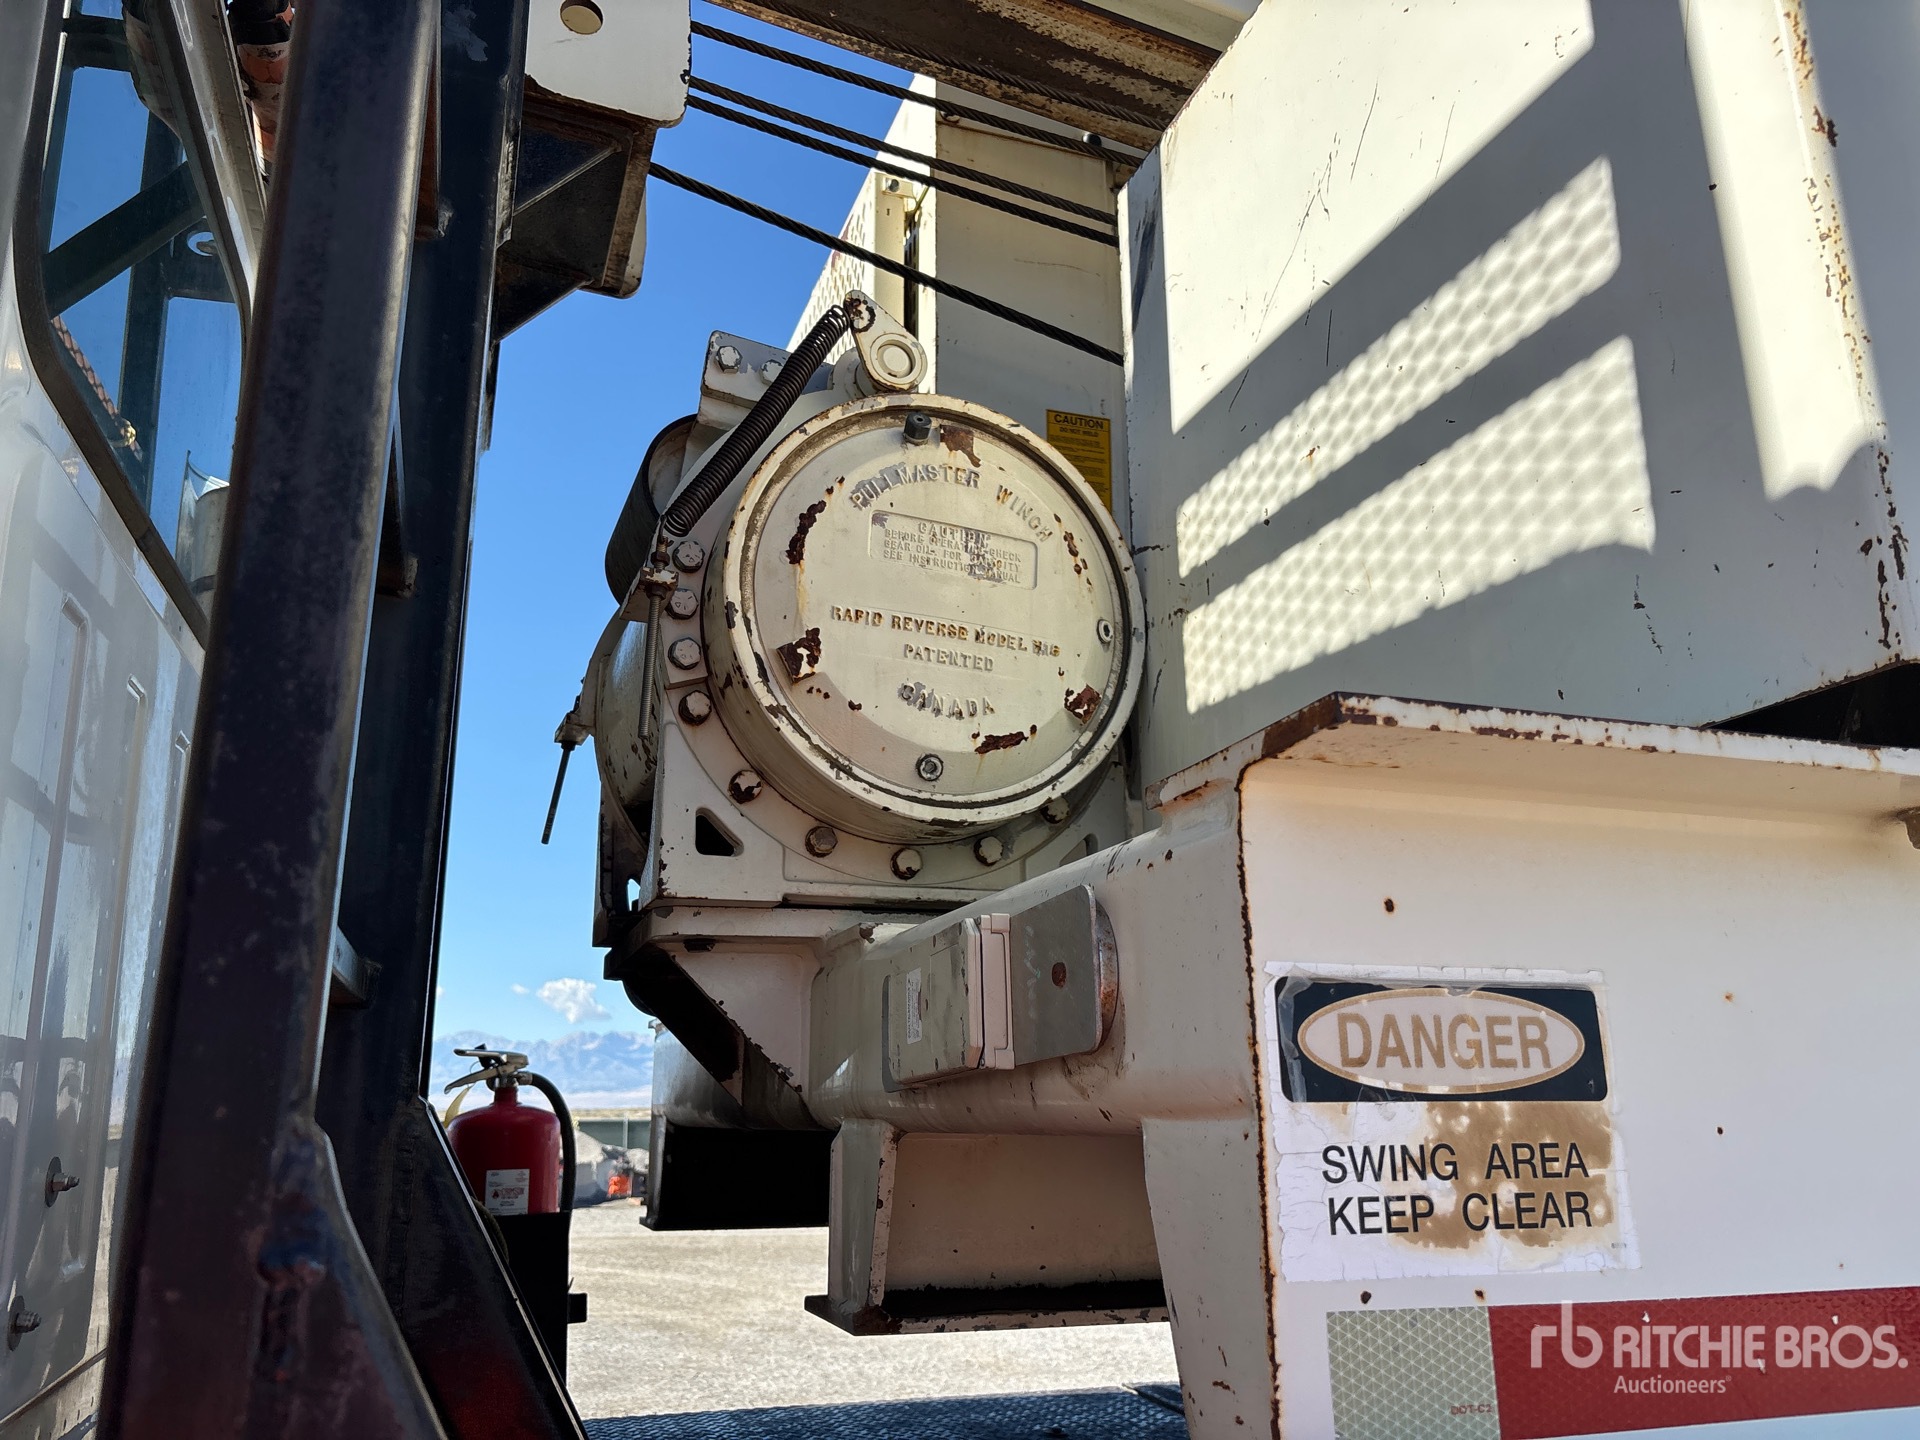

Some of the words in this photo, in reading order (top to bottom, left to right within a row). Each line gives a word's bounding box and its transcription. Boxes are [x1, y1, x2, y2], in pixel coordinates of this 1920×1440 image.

[1054, 414, 1104, 429] CAUTION
[851, 464, 981, 511] PULLMASTER
[996, 485, 1053, 541] WINCH
[885, 528, 925, 543] BEFORE
[884, 550, 903, 561] SEE
[943, 551, 962, 561] FOR
[831, 605, 884, 627] RAPID
[891, 614, 969, 641] REVERSE
[974, 627, 1028, 651] MODEL
[904, 643, 994, 672] PATENTED
[900, 682, 995, 720] CANADA
[1337, 1012, 1553, 1070] DANGER
[1322, 1142, 1459, 1184] SWING
[1485, 1142, 1590, 1180] AREA
[1328, 1194, 1434, 1235] KEEP
[1462, 1191, 1592, 1232] CLEAR
[1451, 1403, 1492, 1415] DOT-C2
